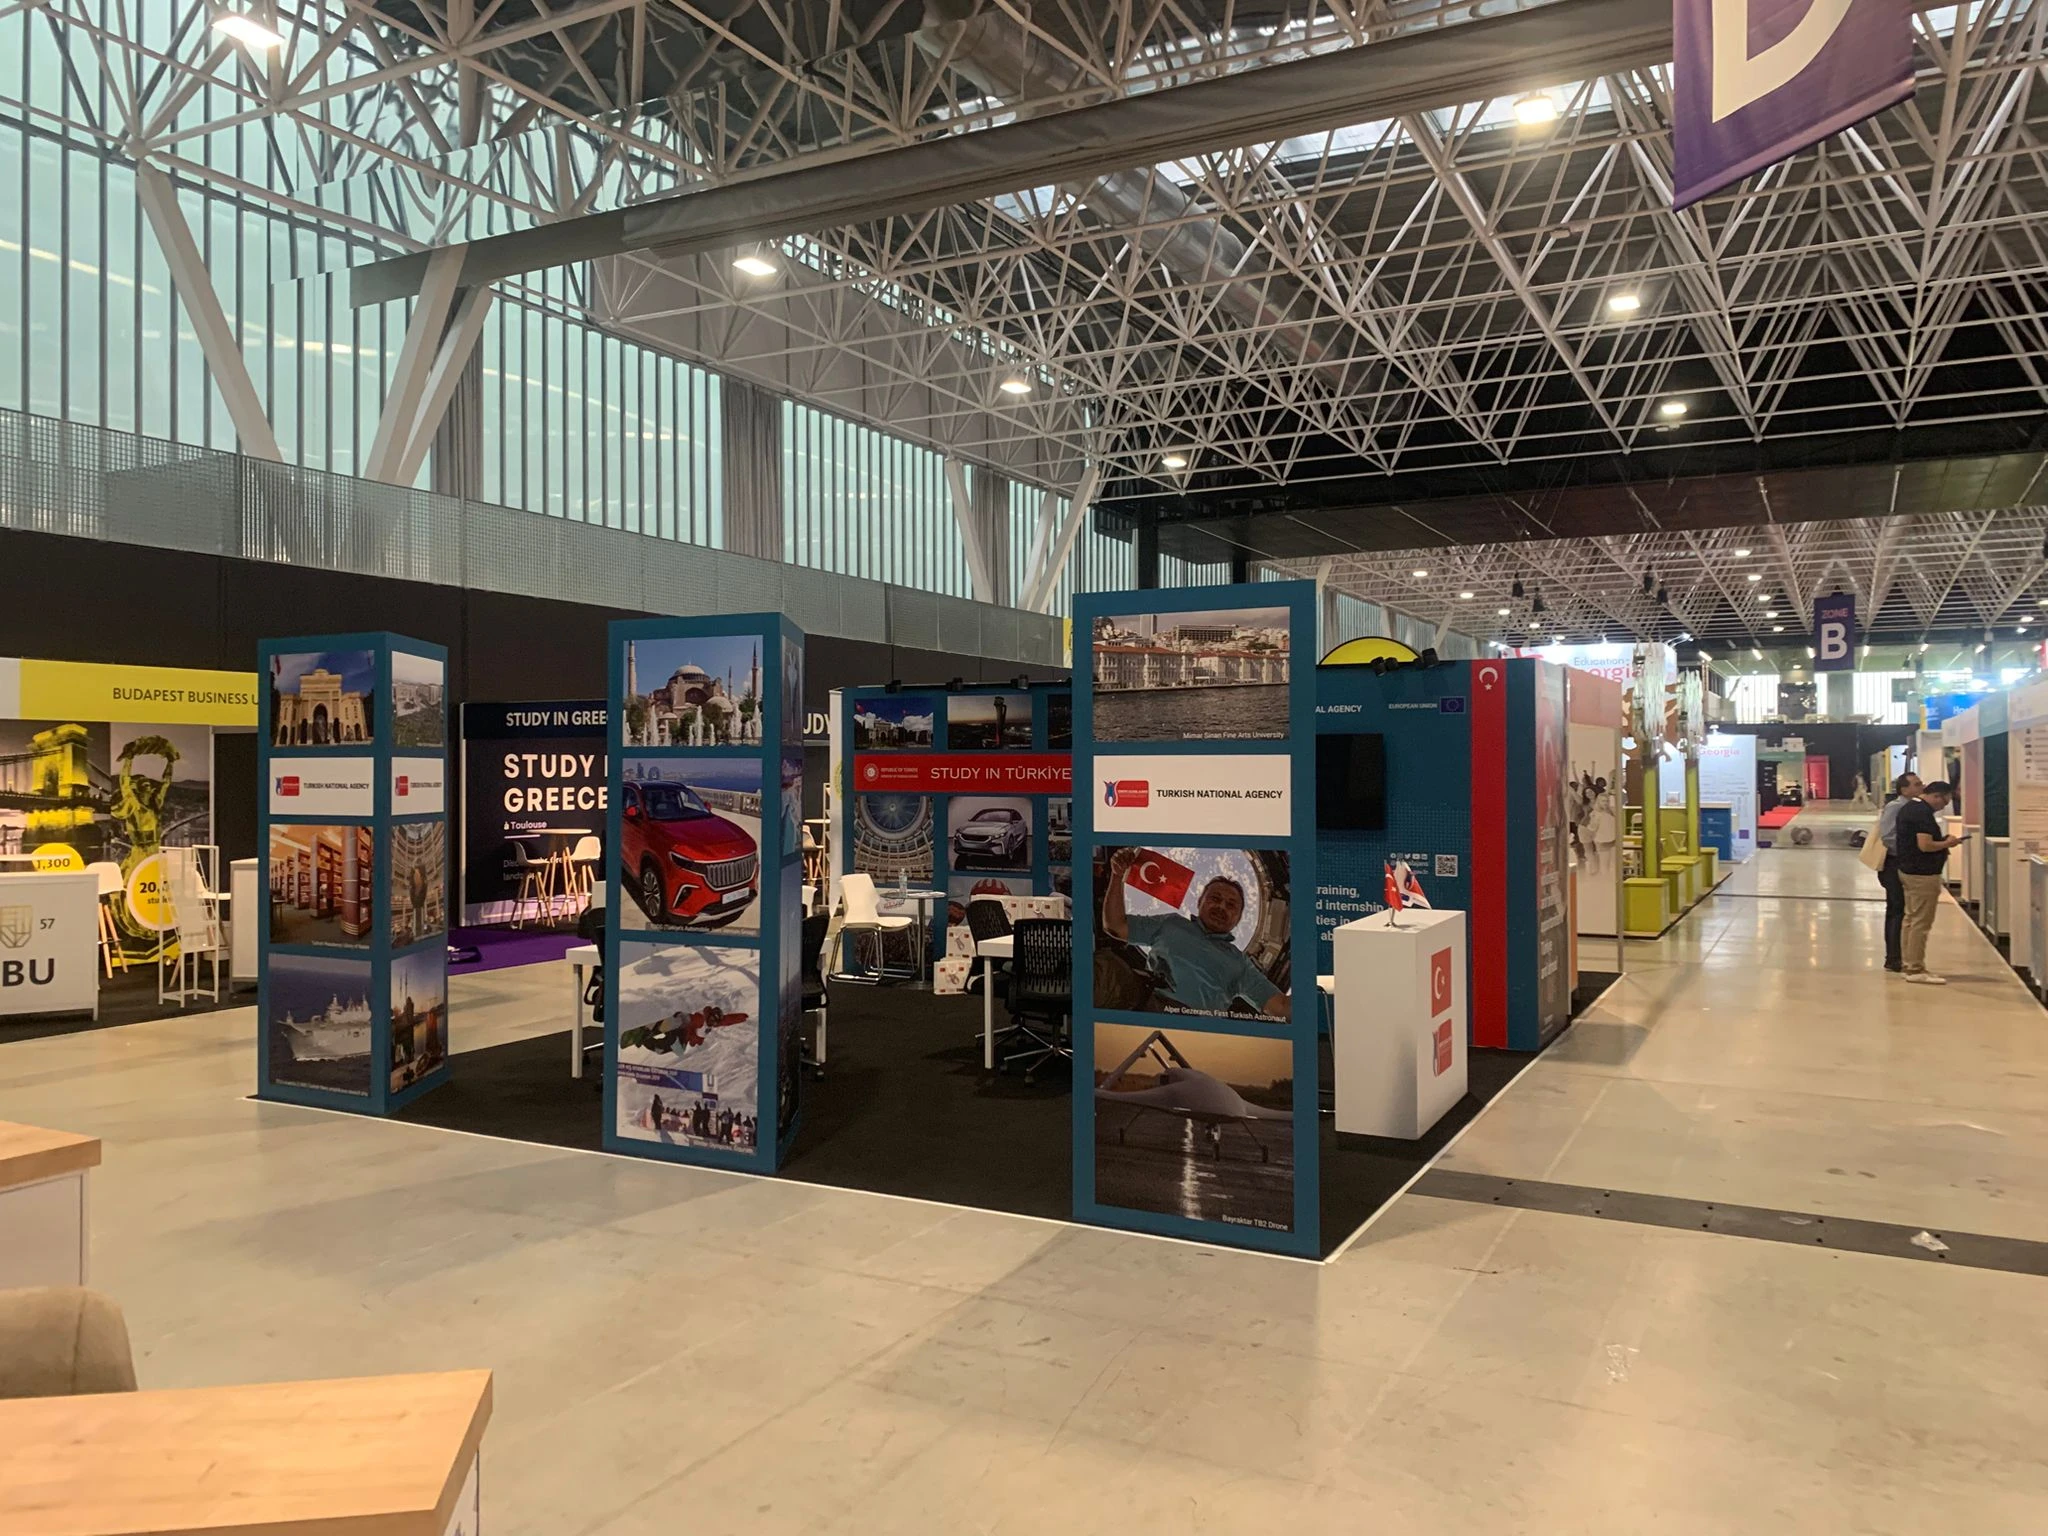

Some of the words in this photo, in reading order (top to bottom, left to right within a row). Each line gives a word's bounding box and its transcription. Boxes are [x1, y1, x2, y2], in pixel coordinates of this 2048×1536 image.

[1712, 0, 1851, 123] D
[1822, 608, 1849, 619] ZONE
[1821, 622, 1848, 660] B
[113, 687, 185, 702] BUDAPEST
[187, 691, 249, 705] BUSINESS
[1328, 704, 1362, 713] AGENCY
[506, 711, 550, 727] STUDY
[553, 711, 568, 726] IN
[571, 710, 609, 726] GREE
[1223, 731, 1237, 739] Fine
[1252, 731, 1284, 739] University
[504, 753, 595, 779] STUDY
[930, 767, 980, 780] STUDY
[986, 767, 1000, 780] IN
[1005, 765, 1072, 780] TÜRKİYE
[325, 782, 348, 790] NATIONAL
[350, 782, 370, 790] AGENCY
[503, 786, 608, 813] GREECE
[1156, 789, 1195, 798] TURKISH
[1197, 789, 1243, 799] NATIONAL
[1245, 790, 1283, 800] AGENCY
[510, 820, 548, 830] Toulouse
[1325, 900, 1385, 913] internship
[40, 918, 56, 930] 57
[1163, 1005, 1181, 1014] Alper
[1214, 1009, 1229, 1018] First
[1230, 1011, 1254, 1020] Turkish
[1254, 1013, 1287, 1023] Astronaut
[1222, 1214, 1253, 1225] Bayraktar
[1253, 1218, 1267, 1228] TB2
[1268, 1221, 1289, 1231] Drone
